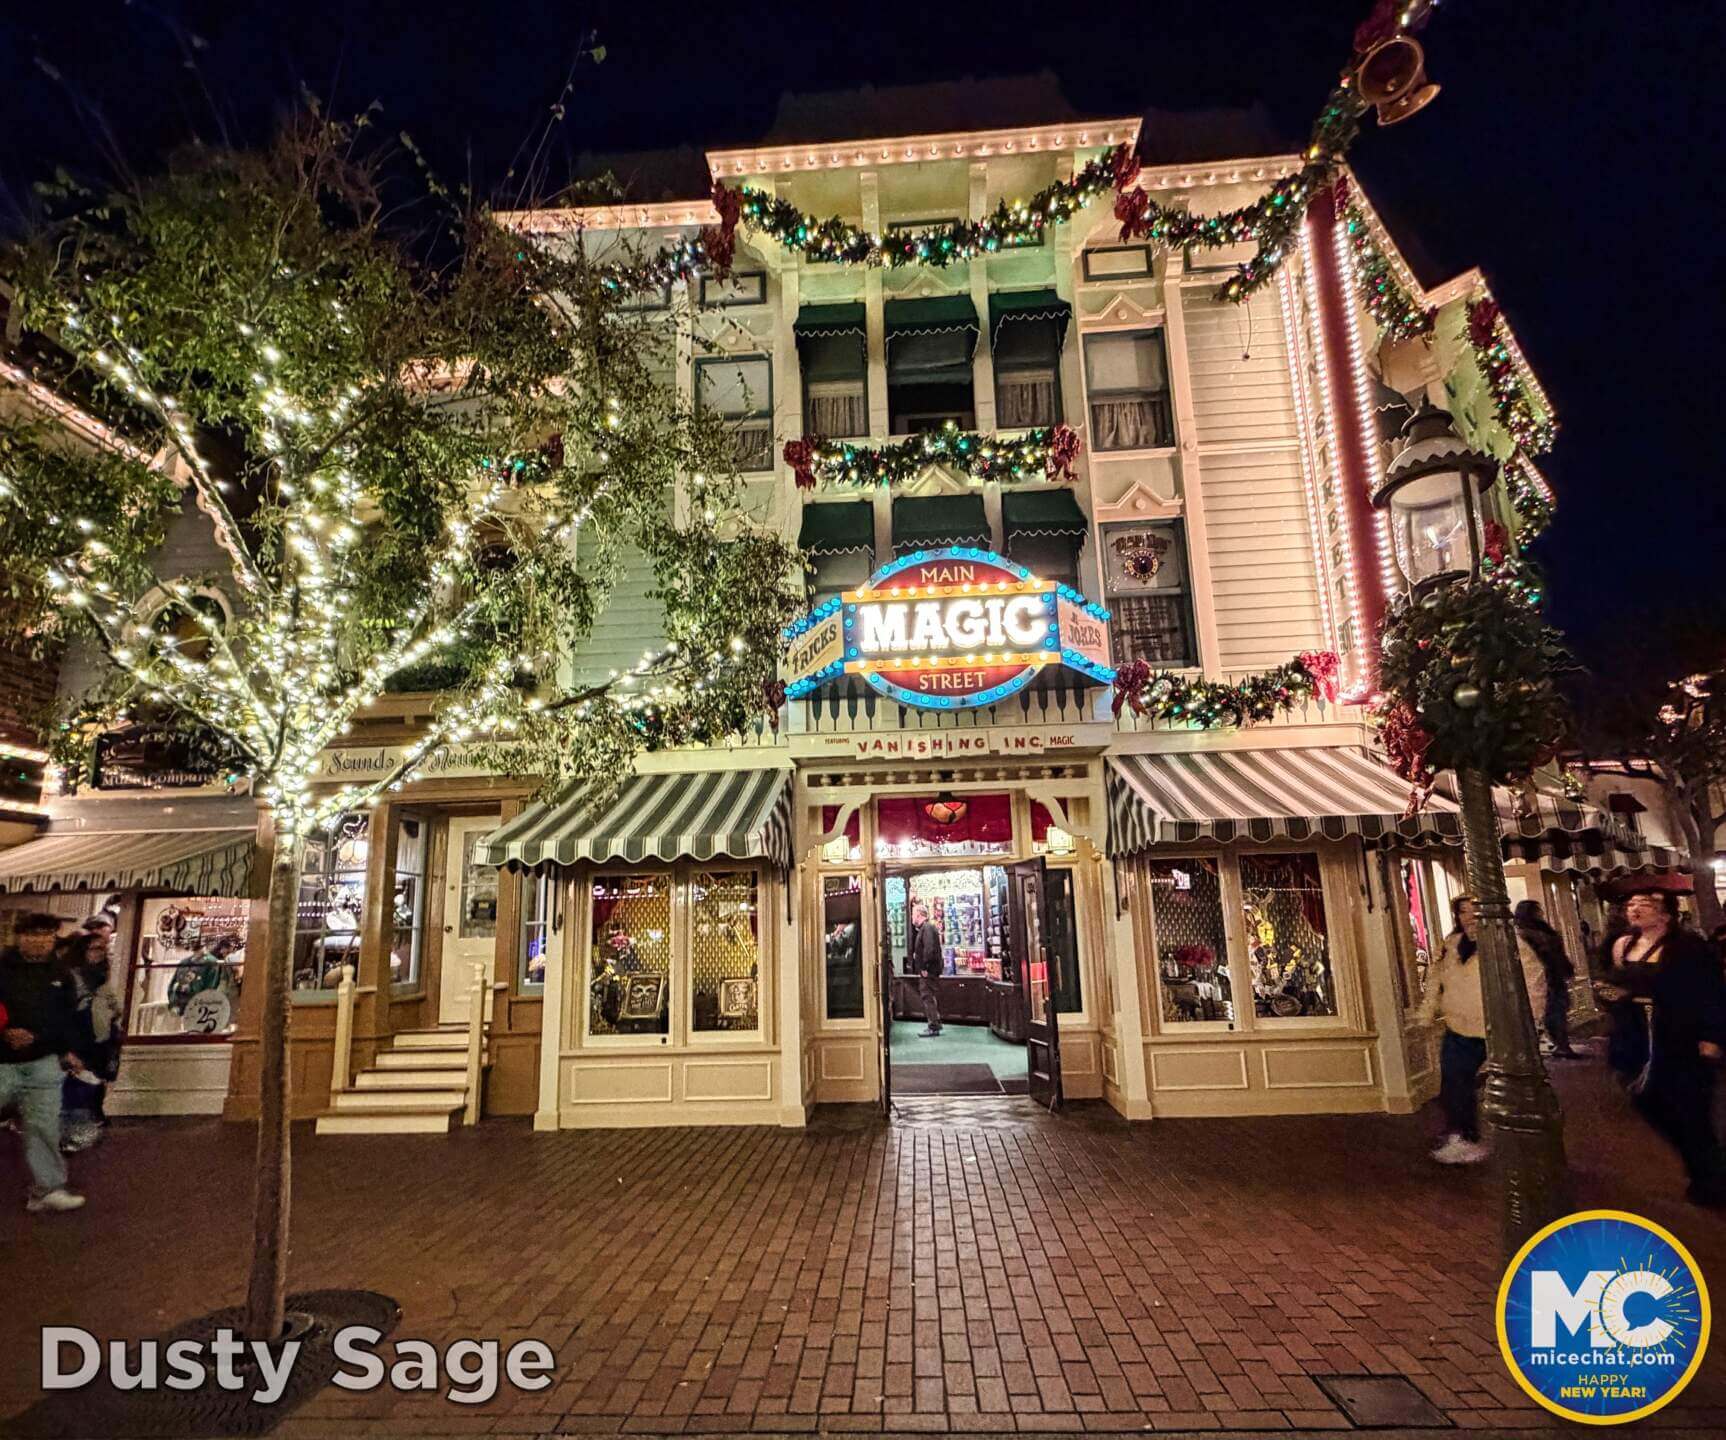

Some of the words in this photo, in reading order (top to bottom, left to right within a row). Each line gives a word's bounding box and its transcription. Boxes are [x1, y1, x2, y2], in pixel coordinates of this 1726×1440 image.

[920, 565, 975, 584] MAIN
[859, 596, 1048, 652] MAGIC
[1068, 624, 1102, 647] JOKES
[793, 623, 837, 675] TRICKS
[919, 671, 986, 690] STREET
[858, 736, 986, 753] VANISHING
[1004, 736, 1043, 748] INC.
[1050, 735, 1075, 746] MAGIC
[197, 1006, 219, 1033] 25
